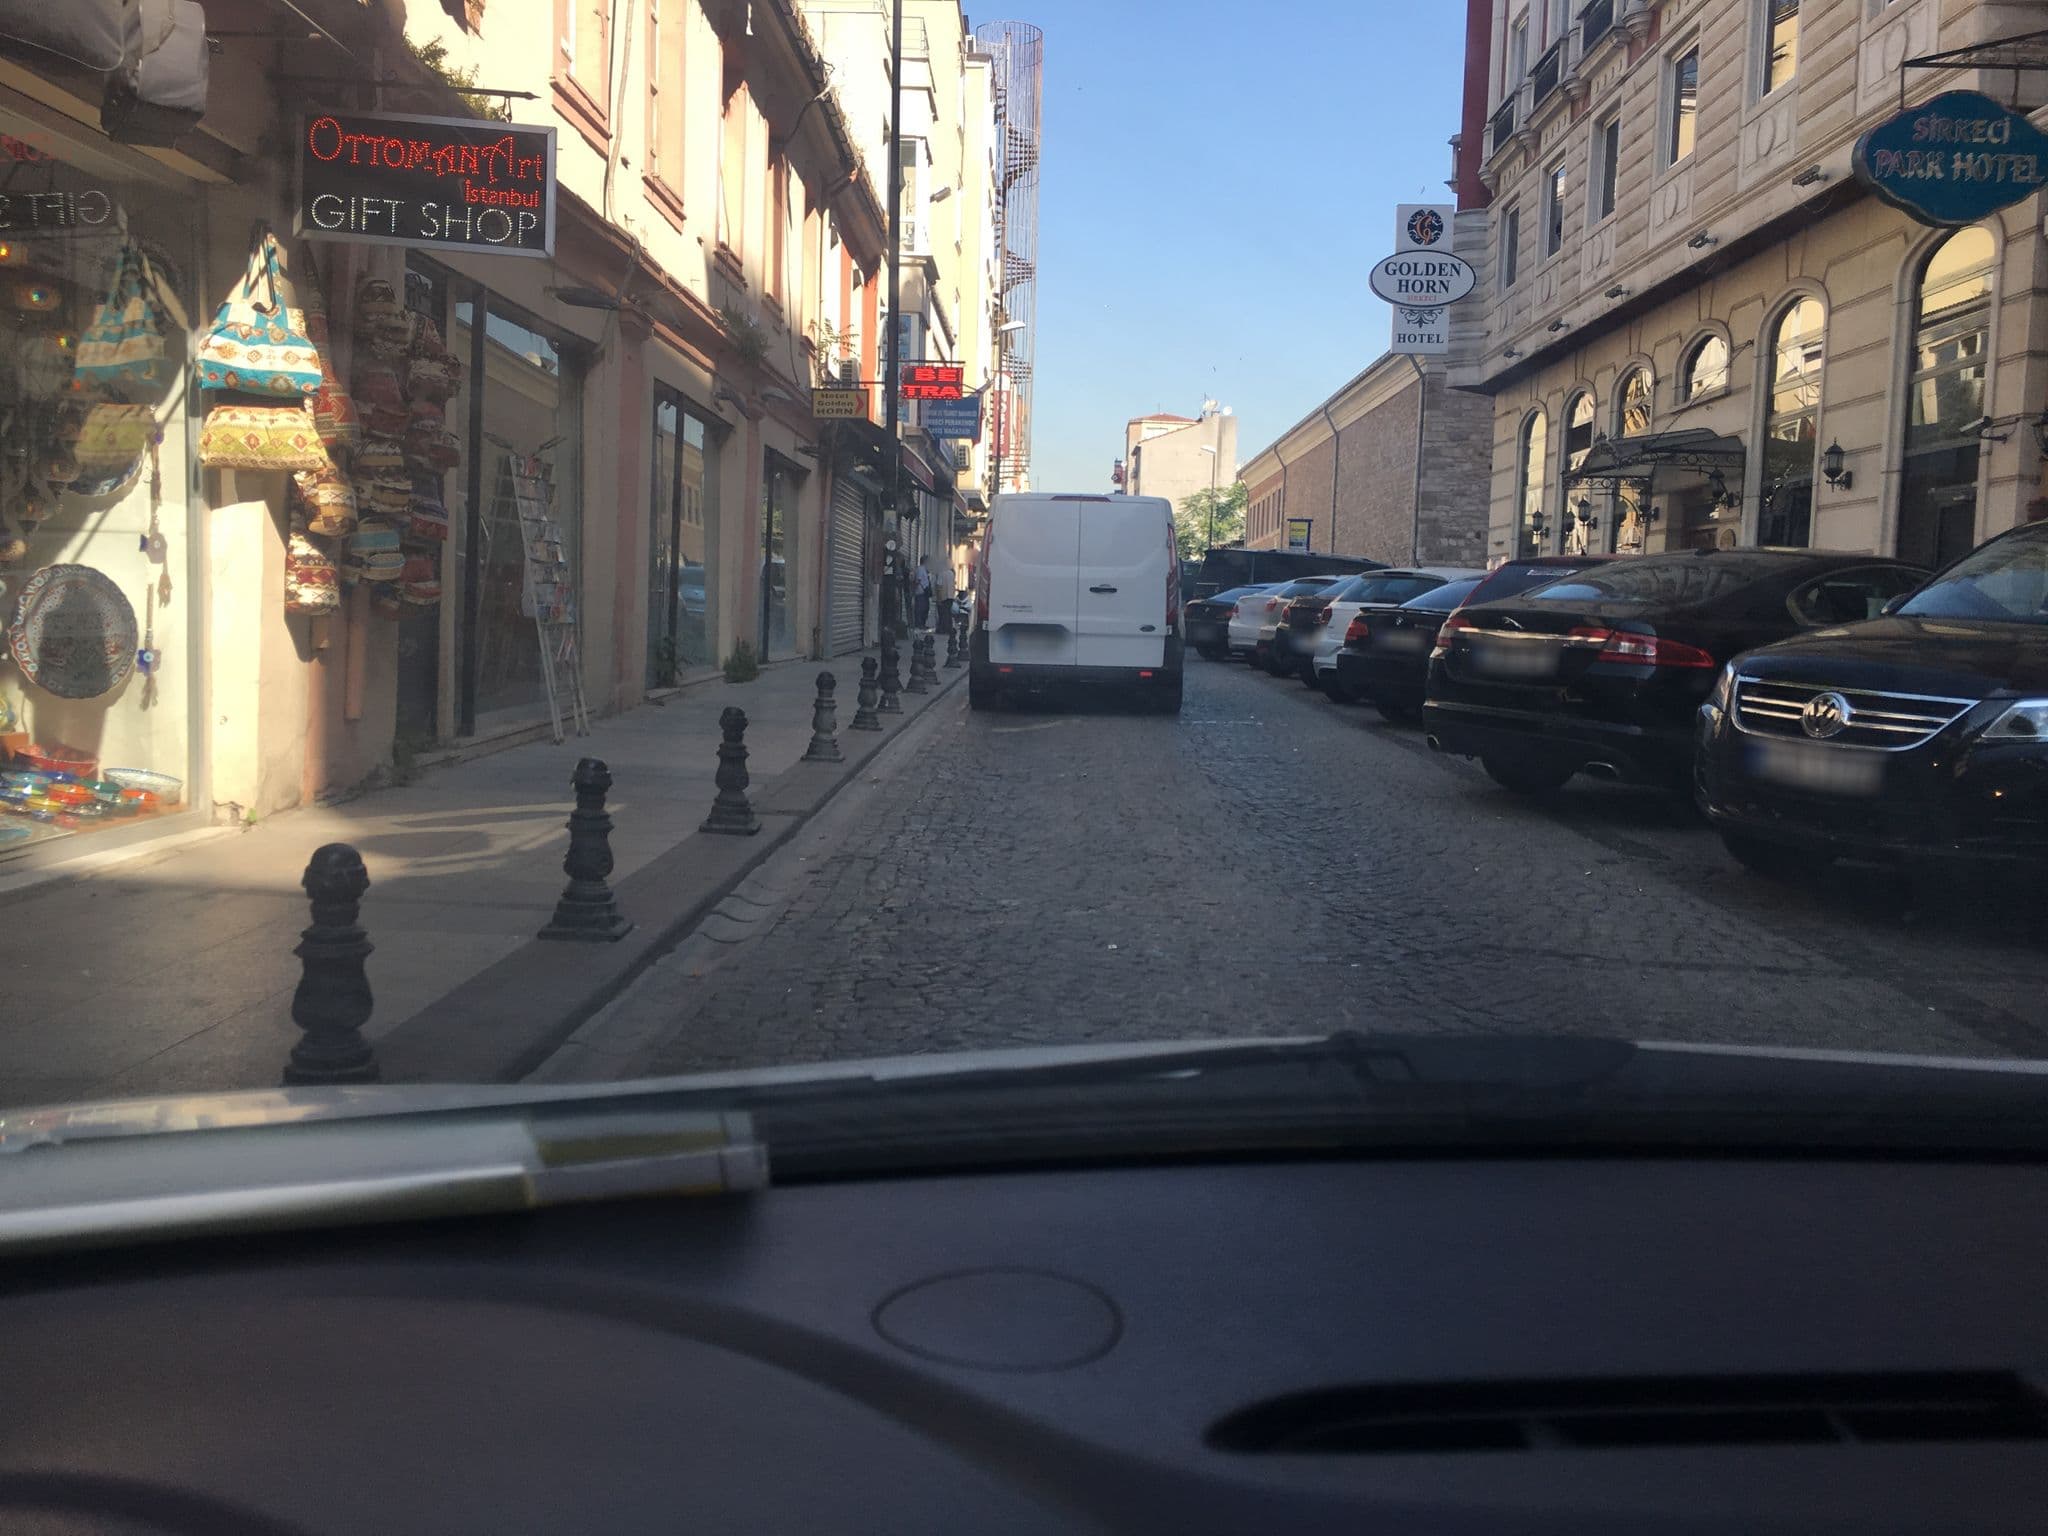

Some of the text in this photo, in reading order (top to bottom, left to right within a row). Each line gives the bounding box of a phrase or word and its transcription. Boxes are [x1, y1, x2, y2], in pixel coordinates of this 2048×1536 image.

[1873, 149, 2046, 183] PARK HOTEL
[311, 194, 537, 244] GIFT SHOP
[1384, 261, 1463, 277] GOLDEN
[1396, 279, 1451, 294] HORN
[1397, 333, 1444, 344] HOTEL
[914, 368, 957, 382] BE
[903, 385, 961, 398] TRA
[816, 408, 854, 416] HORN
